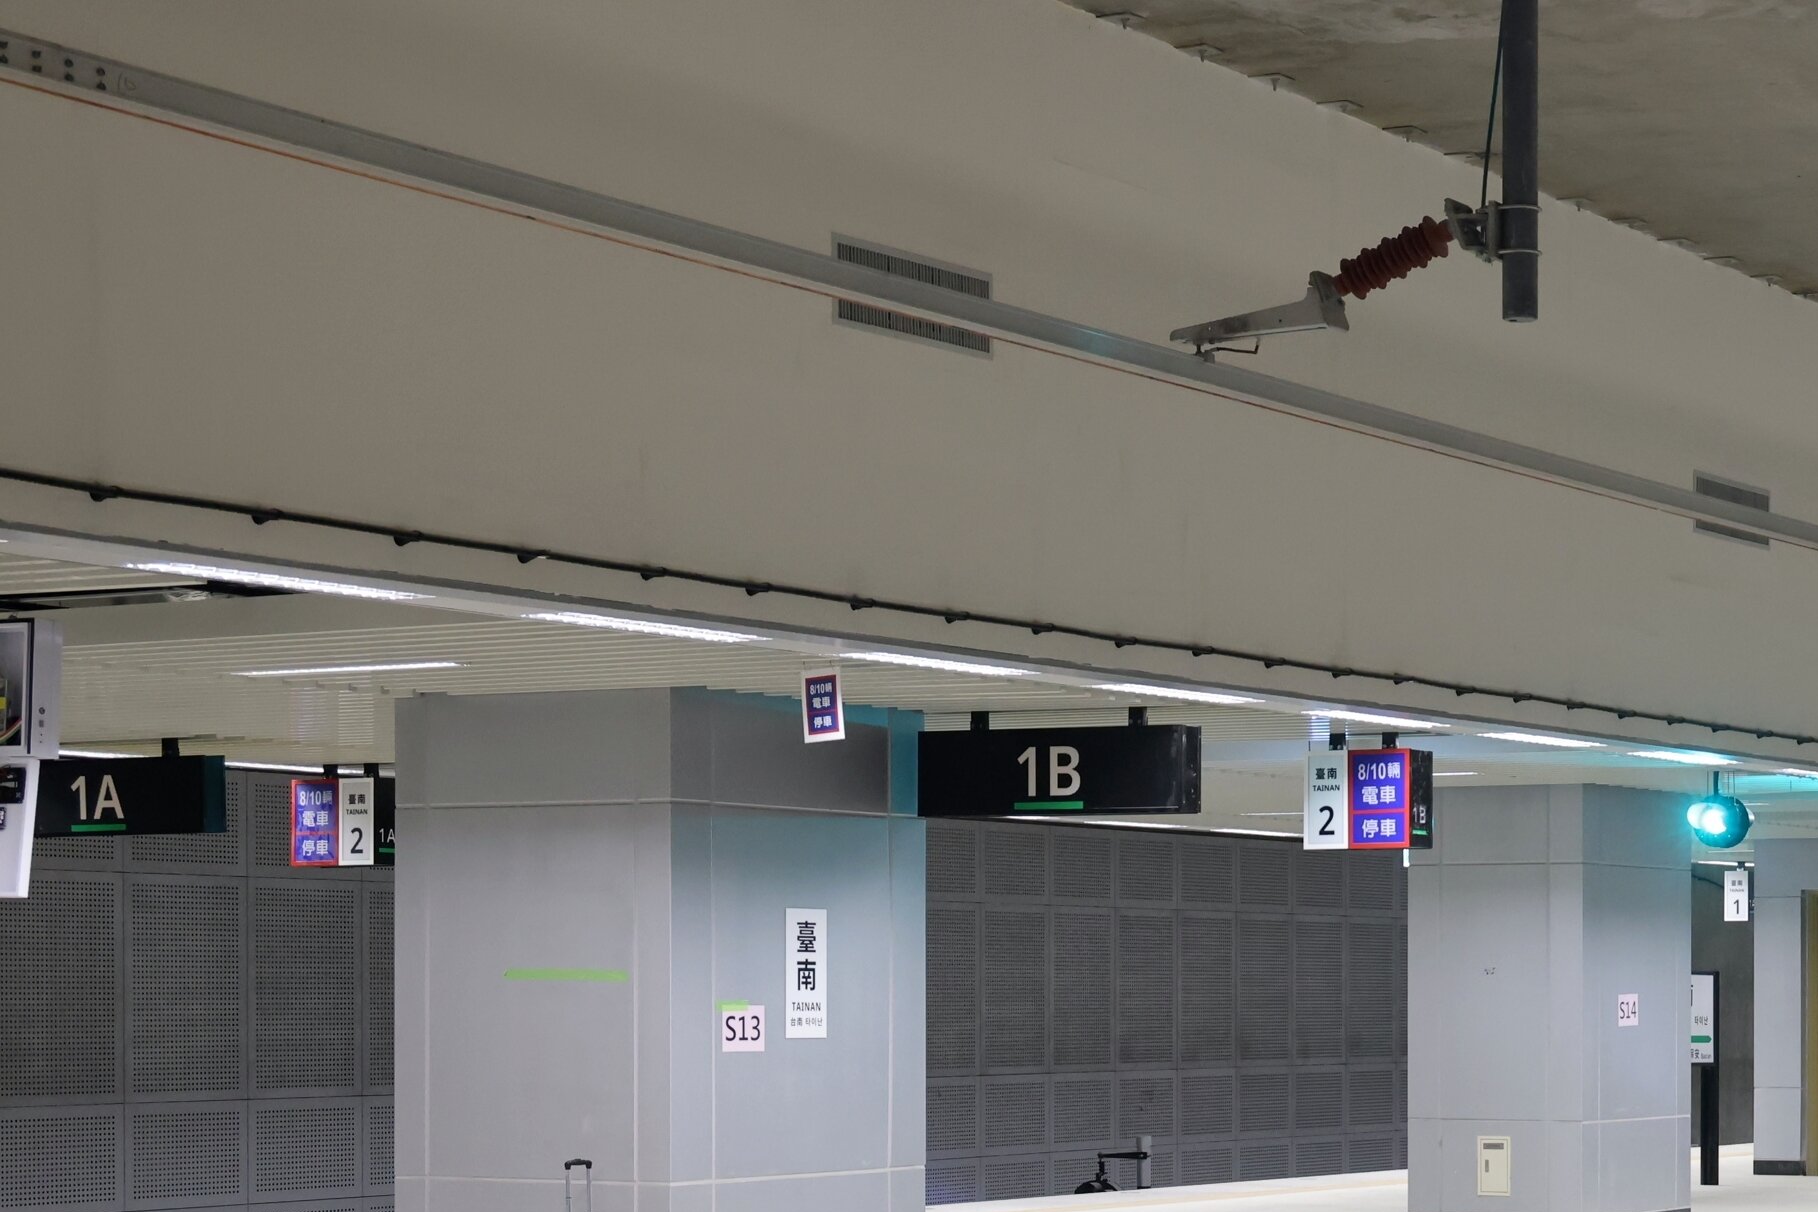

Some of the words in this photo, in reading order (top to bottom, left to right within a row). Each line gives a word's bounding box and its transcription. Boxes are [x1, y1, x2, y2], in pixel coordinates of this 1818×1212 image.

[1017, 745, 1081, 797] 1B
[1315, 767, 1337, 780] 臺南
[1358, 762, 1400, 781] 8/10輛
[70, 774, 125, 820] 1A
[1312, 784, 1340, 792] TAINAN
[1361, 785, 1396, 805] 電車
[302, 810, 328, 827] 電車
[1318, 805, 1335, 836] 2
[1412, 806, 1426, 824] 1B
[1361, 819, 1396, 838] 停車
[302, 840, 329, 856] 停車
[350, 827, 364, 854] 2
[1733, 899, 1739, 914] 1
[797, 920, 817, 991] 臺南
[792, 1002, 821, 1011] TAINAN
[1619, 1001, 1637, 1020] S14
[725, 1015, 761, 1041] S13
